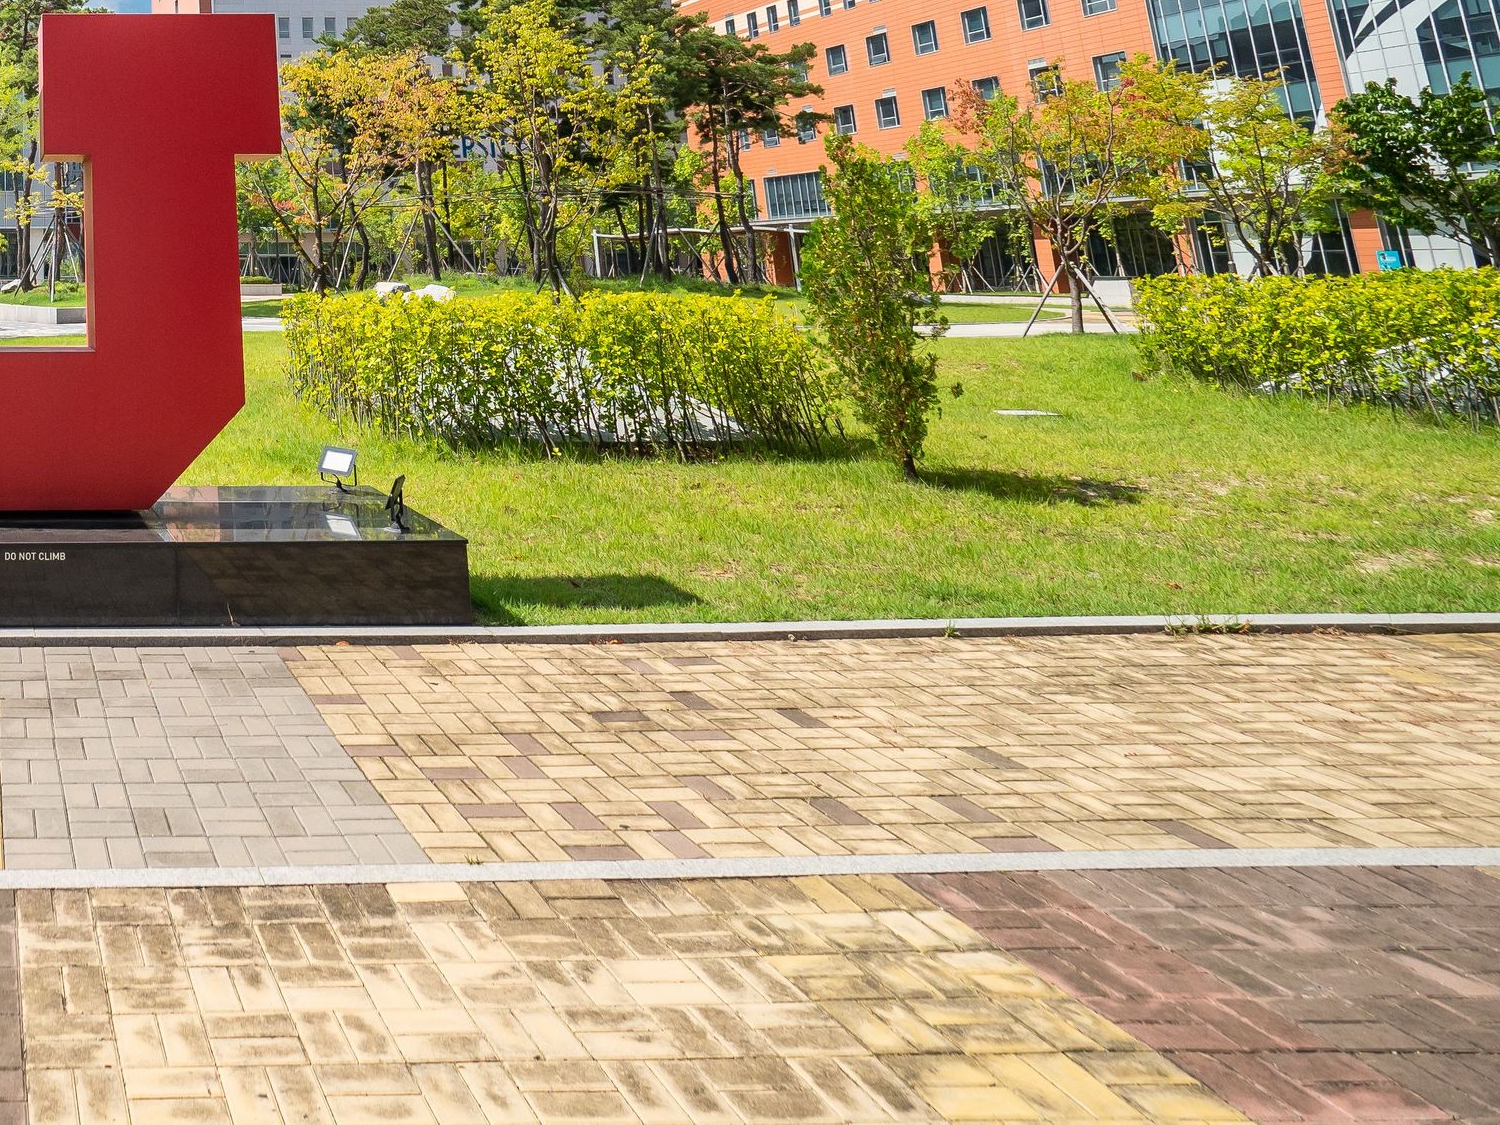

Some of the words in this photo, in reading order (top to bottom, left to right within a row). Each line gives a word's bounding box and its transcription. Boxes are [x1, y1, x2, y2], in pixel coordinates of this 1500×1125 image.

[4, 552, 17, 561] DO
[18, 552, 37, 561] NOT
[38, 552, 66, 561] CLIMB
